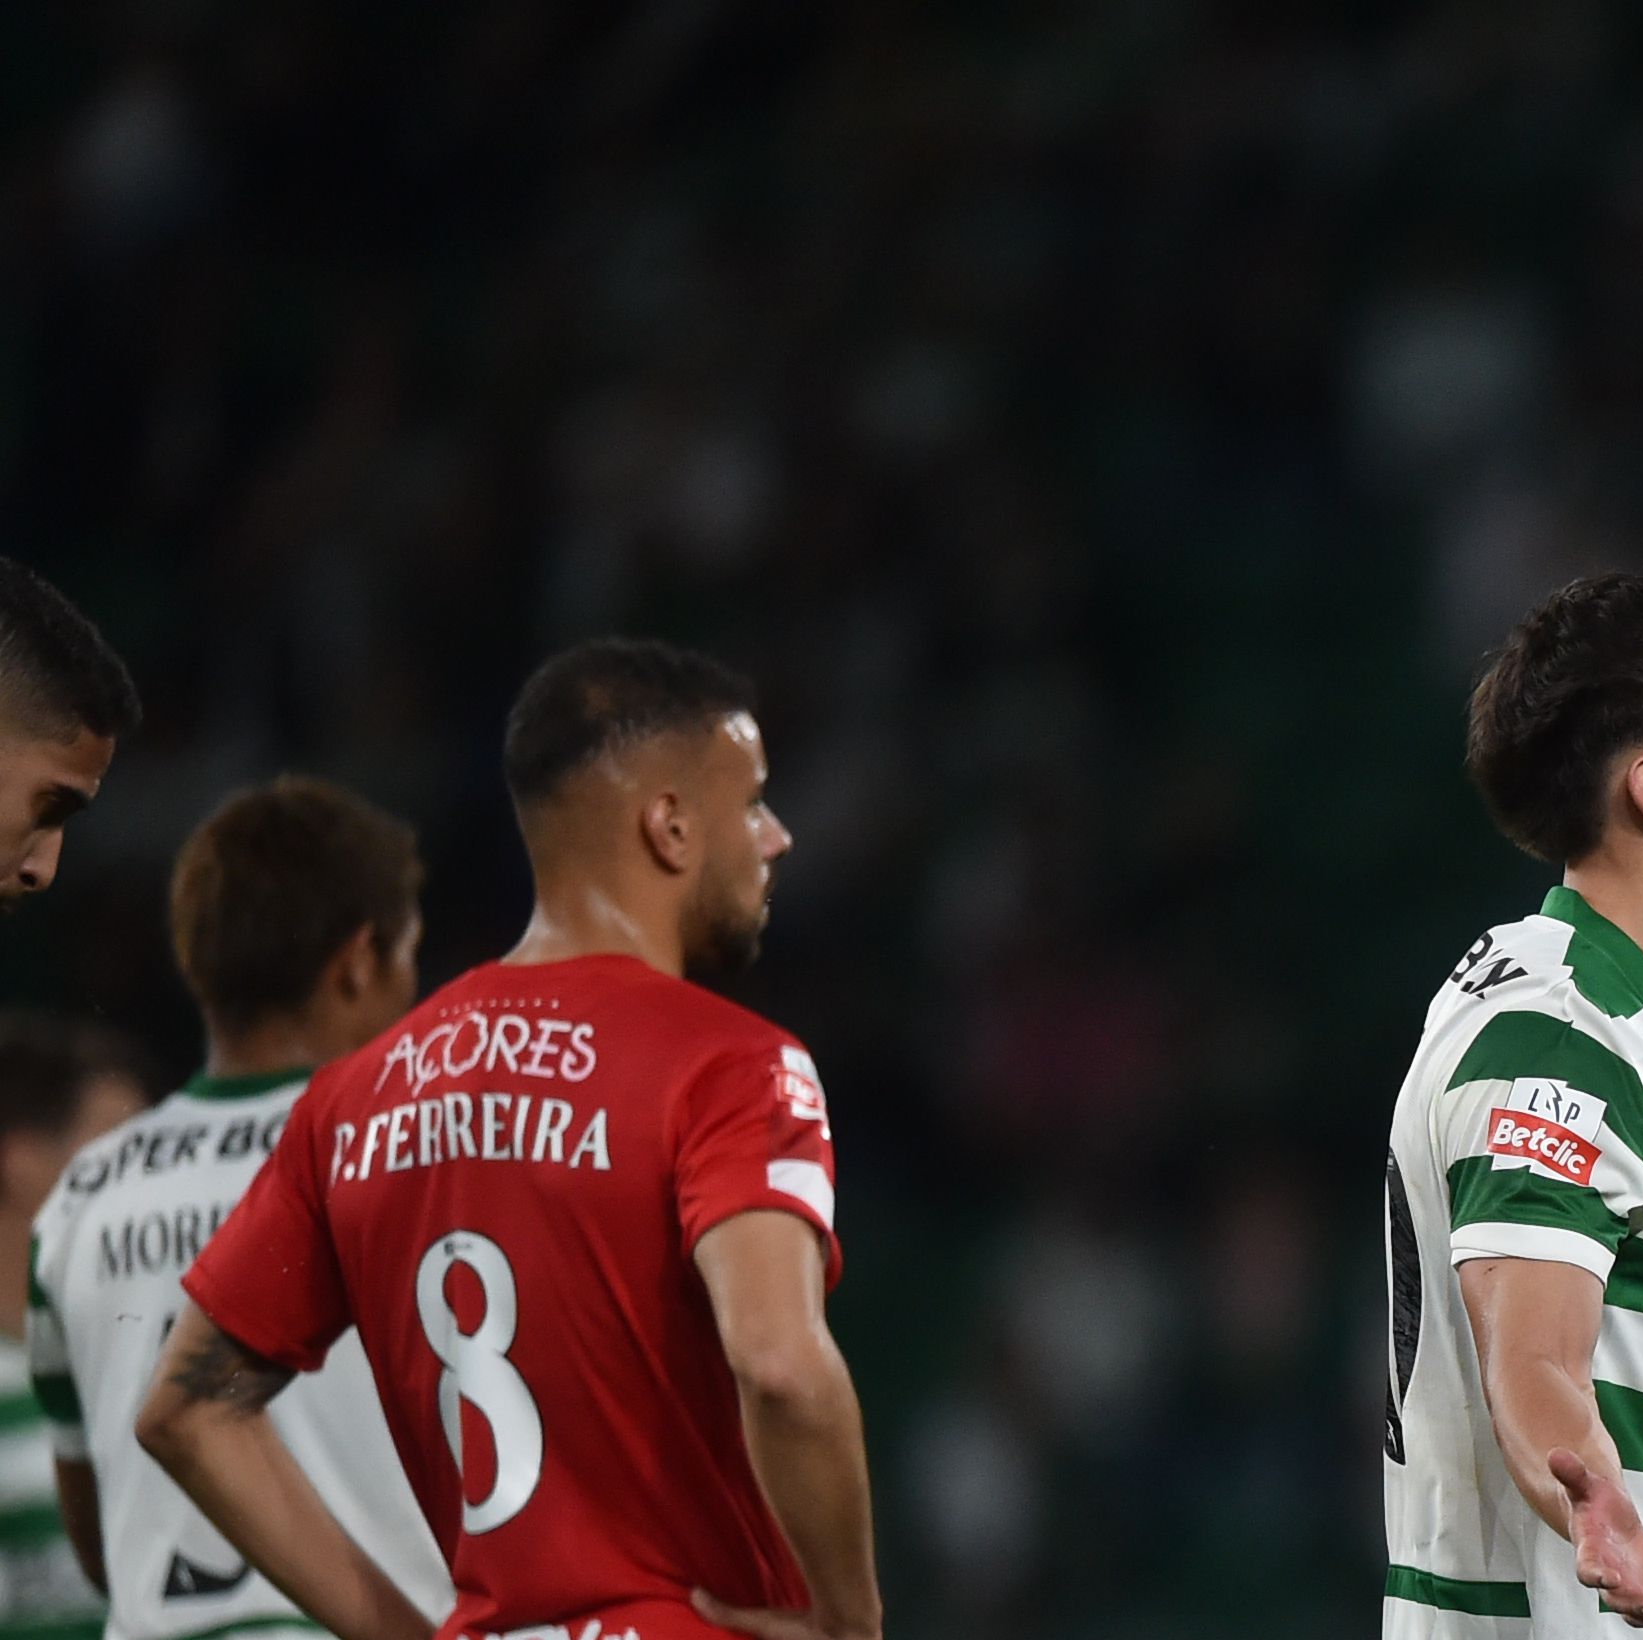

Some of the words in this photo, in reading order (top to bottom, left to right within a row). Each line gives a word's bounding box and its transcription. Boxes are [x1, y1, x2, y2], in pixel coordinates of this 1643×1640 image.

[374, 1010, 597, 1098] AÇORES
[328, 1091, 612, 1190] P.FERREIRA
[1493, 1117, 1587, 1175] Betclic
[415, 1229, 544, 1537] 8
